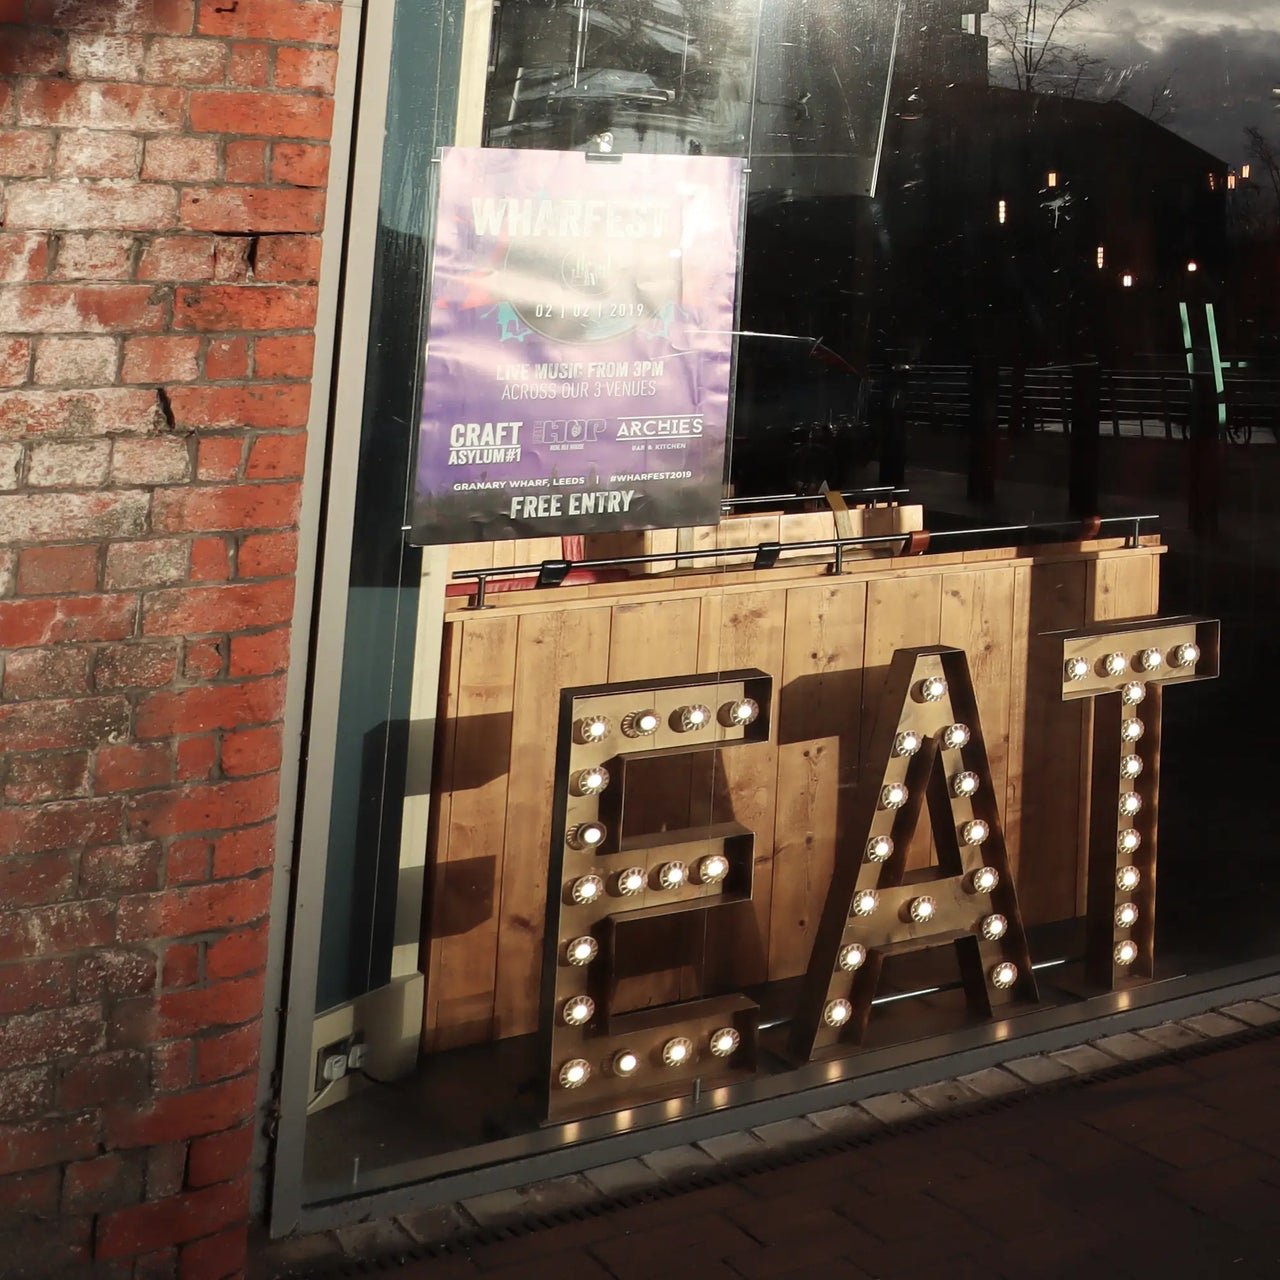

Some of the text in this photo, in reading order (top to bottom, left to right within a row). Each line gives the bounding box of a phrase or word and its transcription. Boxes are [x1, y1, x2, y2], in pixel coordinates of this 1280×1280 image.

[471, 198, 669, 238] WHARFEST
[535, 303, 644, 318] 02 02 2019
[496, 360, 665, 381] LIVE MUSIC FROM 3PM
[502, 380, 656, 401] ACROSS OUR 3 VENUES
[450, 421, 524, 448] CRAFT
[448, 448, 522, 466] ASYLUM#1
[655, 442, 687, 451] KITCHEN
[453, 476, 585, 492] GRANARY WHARF, LEEDS
[610, 470, 692, 483] #WHARFEST2019
[510, 490, 635, 520] FREE ENTRY
[545, 619, 1222, 1121] EAT
